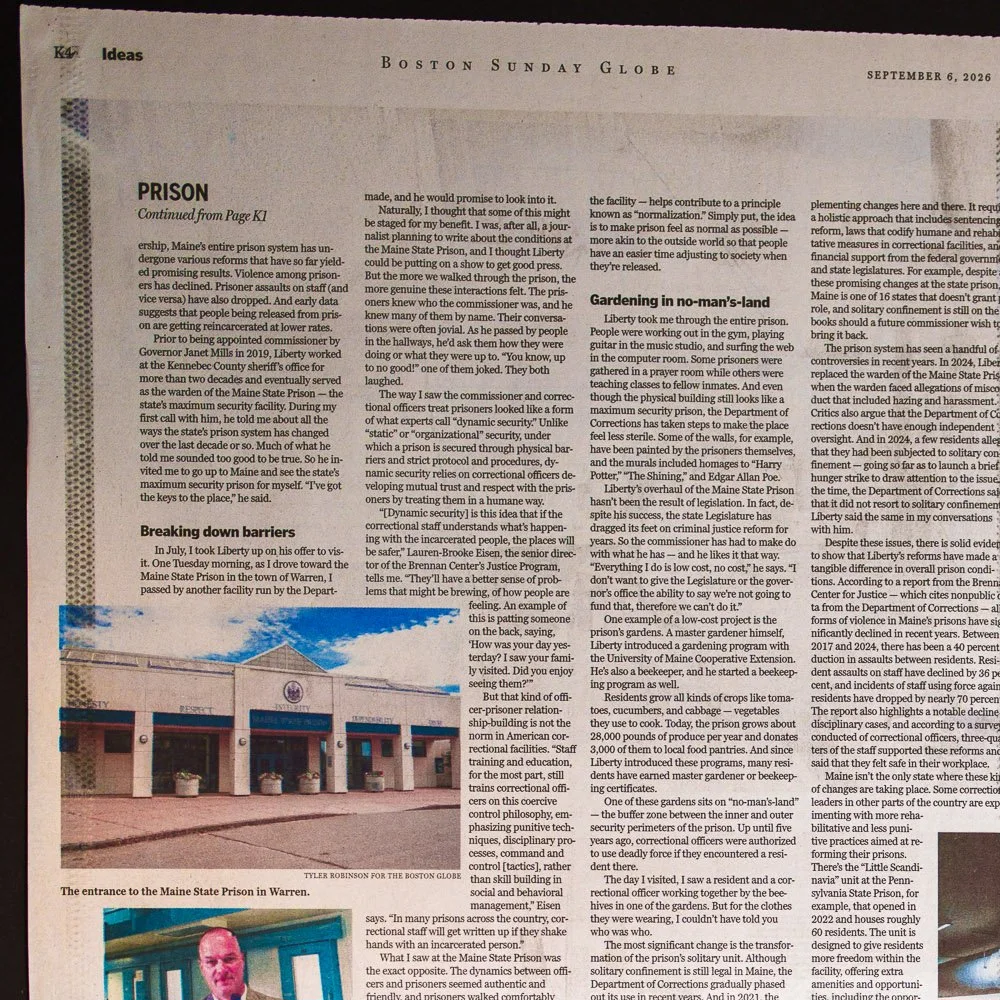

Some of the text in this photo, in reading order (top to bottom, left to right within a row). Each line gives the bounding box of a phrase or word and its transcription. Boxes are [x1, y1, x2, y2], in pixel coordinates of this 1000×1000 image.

[102, 47, 144, 61] Ideas
[866, 70, 991, 82] SEPTEMBER 6, 2026
[138, 181, 208, 201] PRISON
[137, 207, 267, 224] Continued from Page K1
[589, 261, 661, 272] they’re released.
[589, 293, 770, 308] Gardening in no-man’s-land
[140, 524, 296, 539] Breaking down barriers
[60, 886, 310, 896] The entrance to the Maine State Prison in Warren.
[811, 914, 920, 926] 2022 and houses roughly
